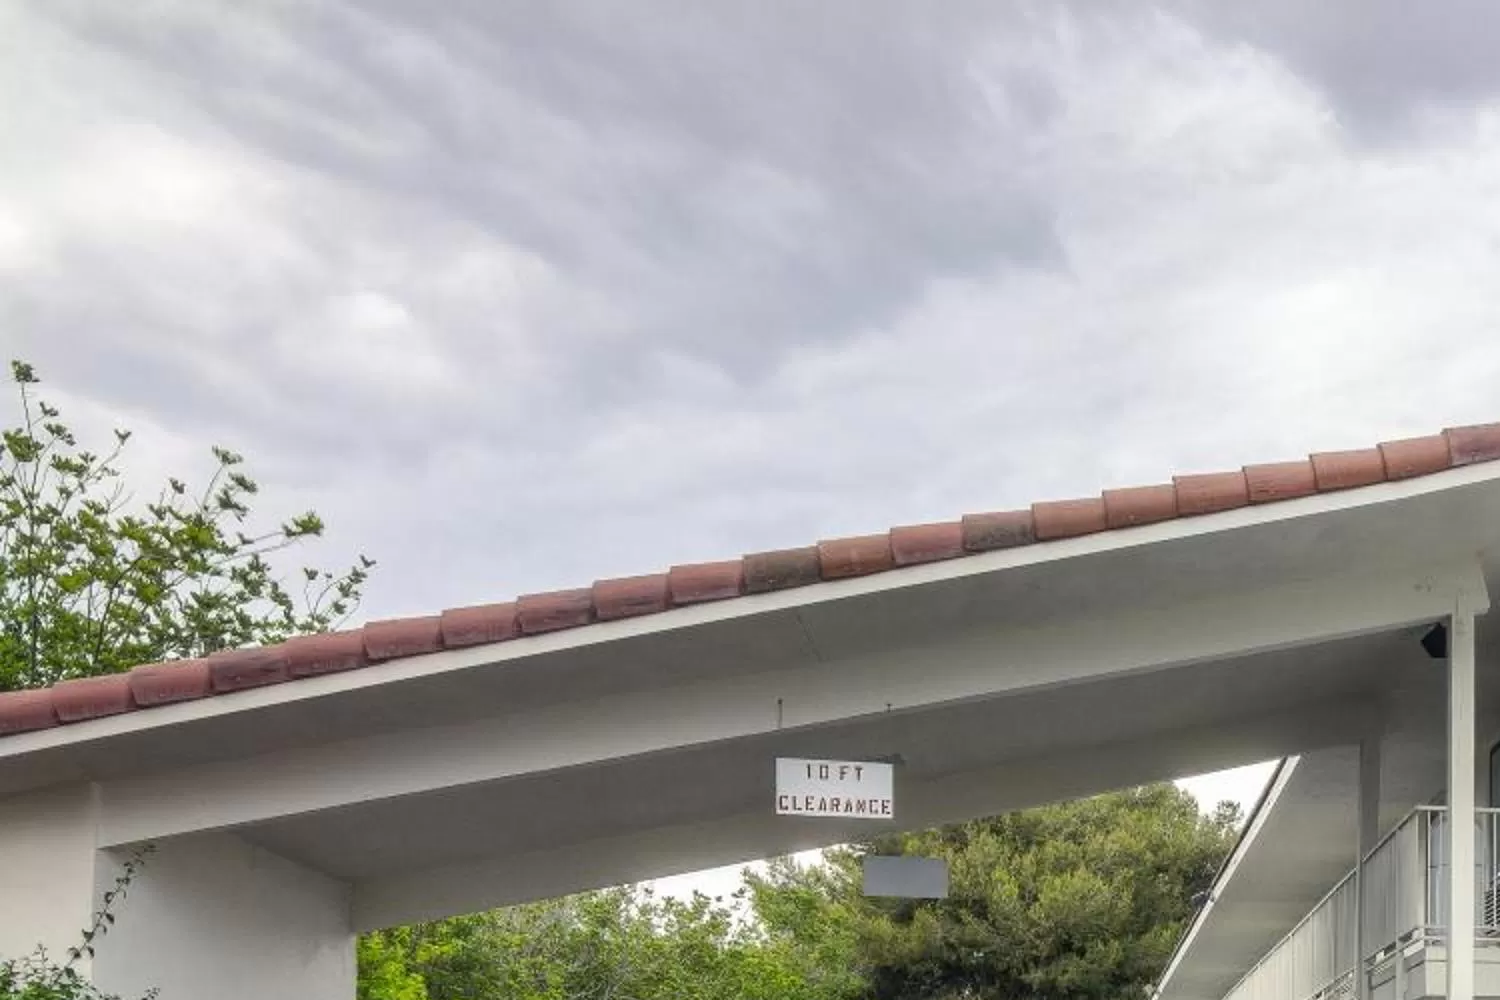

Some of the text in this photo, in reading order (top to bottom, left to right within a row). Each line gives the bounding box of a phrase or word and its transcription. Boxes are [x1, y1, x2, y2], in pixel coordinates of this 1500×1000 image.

[806, 763, 864, 782] 10 FT
[779, 795, 892, 815] CLEARANCE
